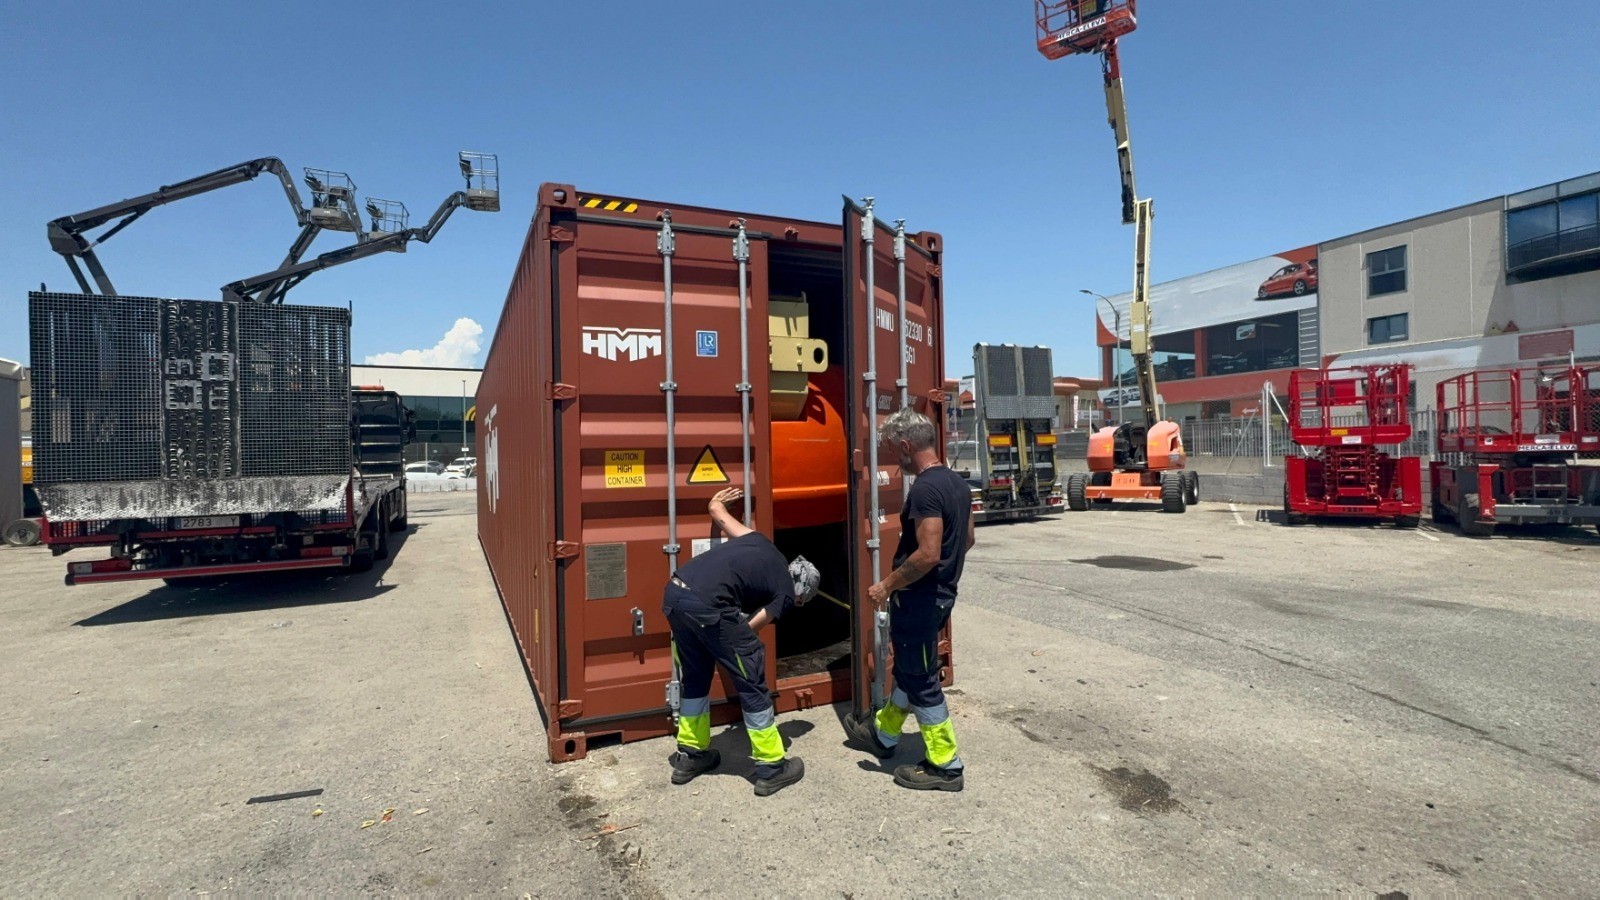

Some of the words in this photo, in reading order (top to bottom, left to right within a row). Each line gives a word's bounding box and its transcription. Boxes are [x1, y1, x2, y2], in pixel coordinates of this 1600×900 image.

[582, 327, 662, 362] HMM
[704, 335, 714, 347] LR
[611, 452, 639, 461] CAUTION
[617, 465, 632, 473] HIGH
[607, 476, 643, 485] CONTAINER
[183, 518, 212, 528] 2783
